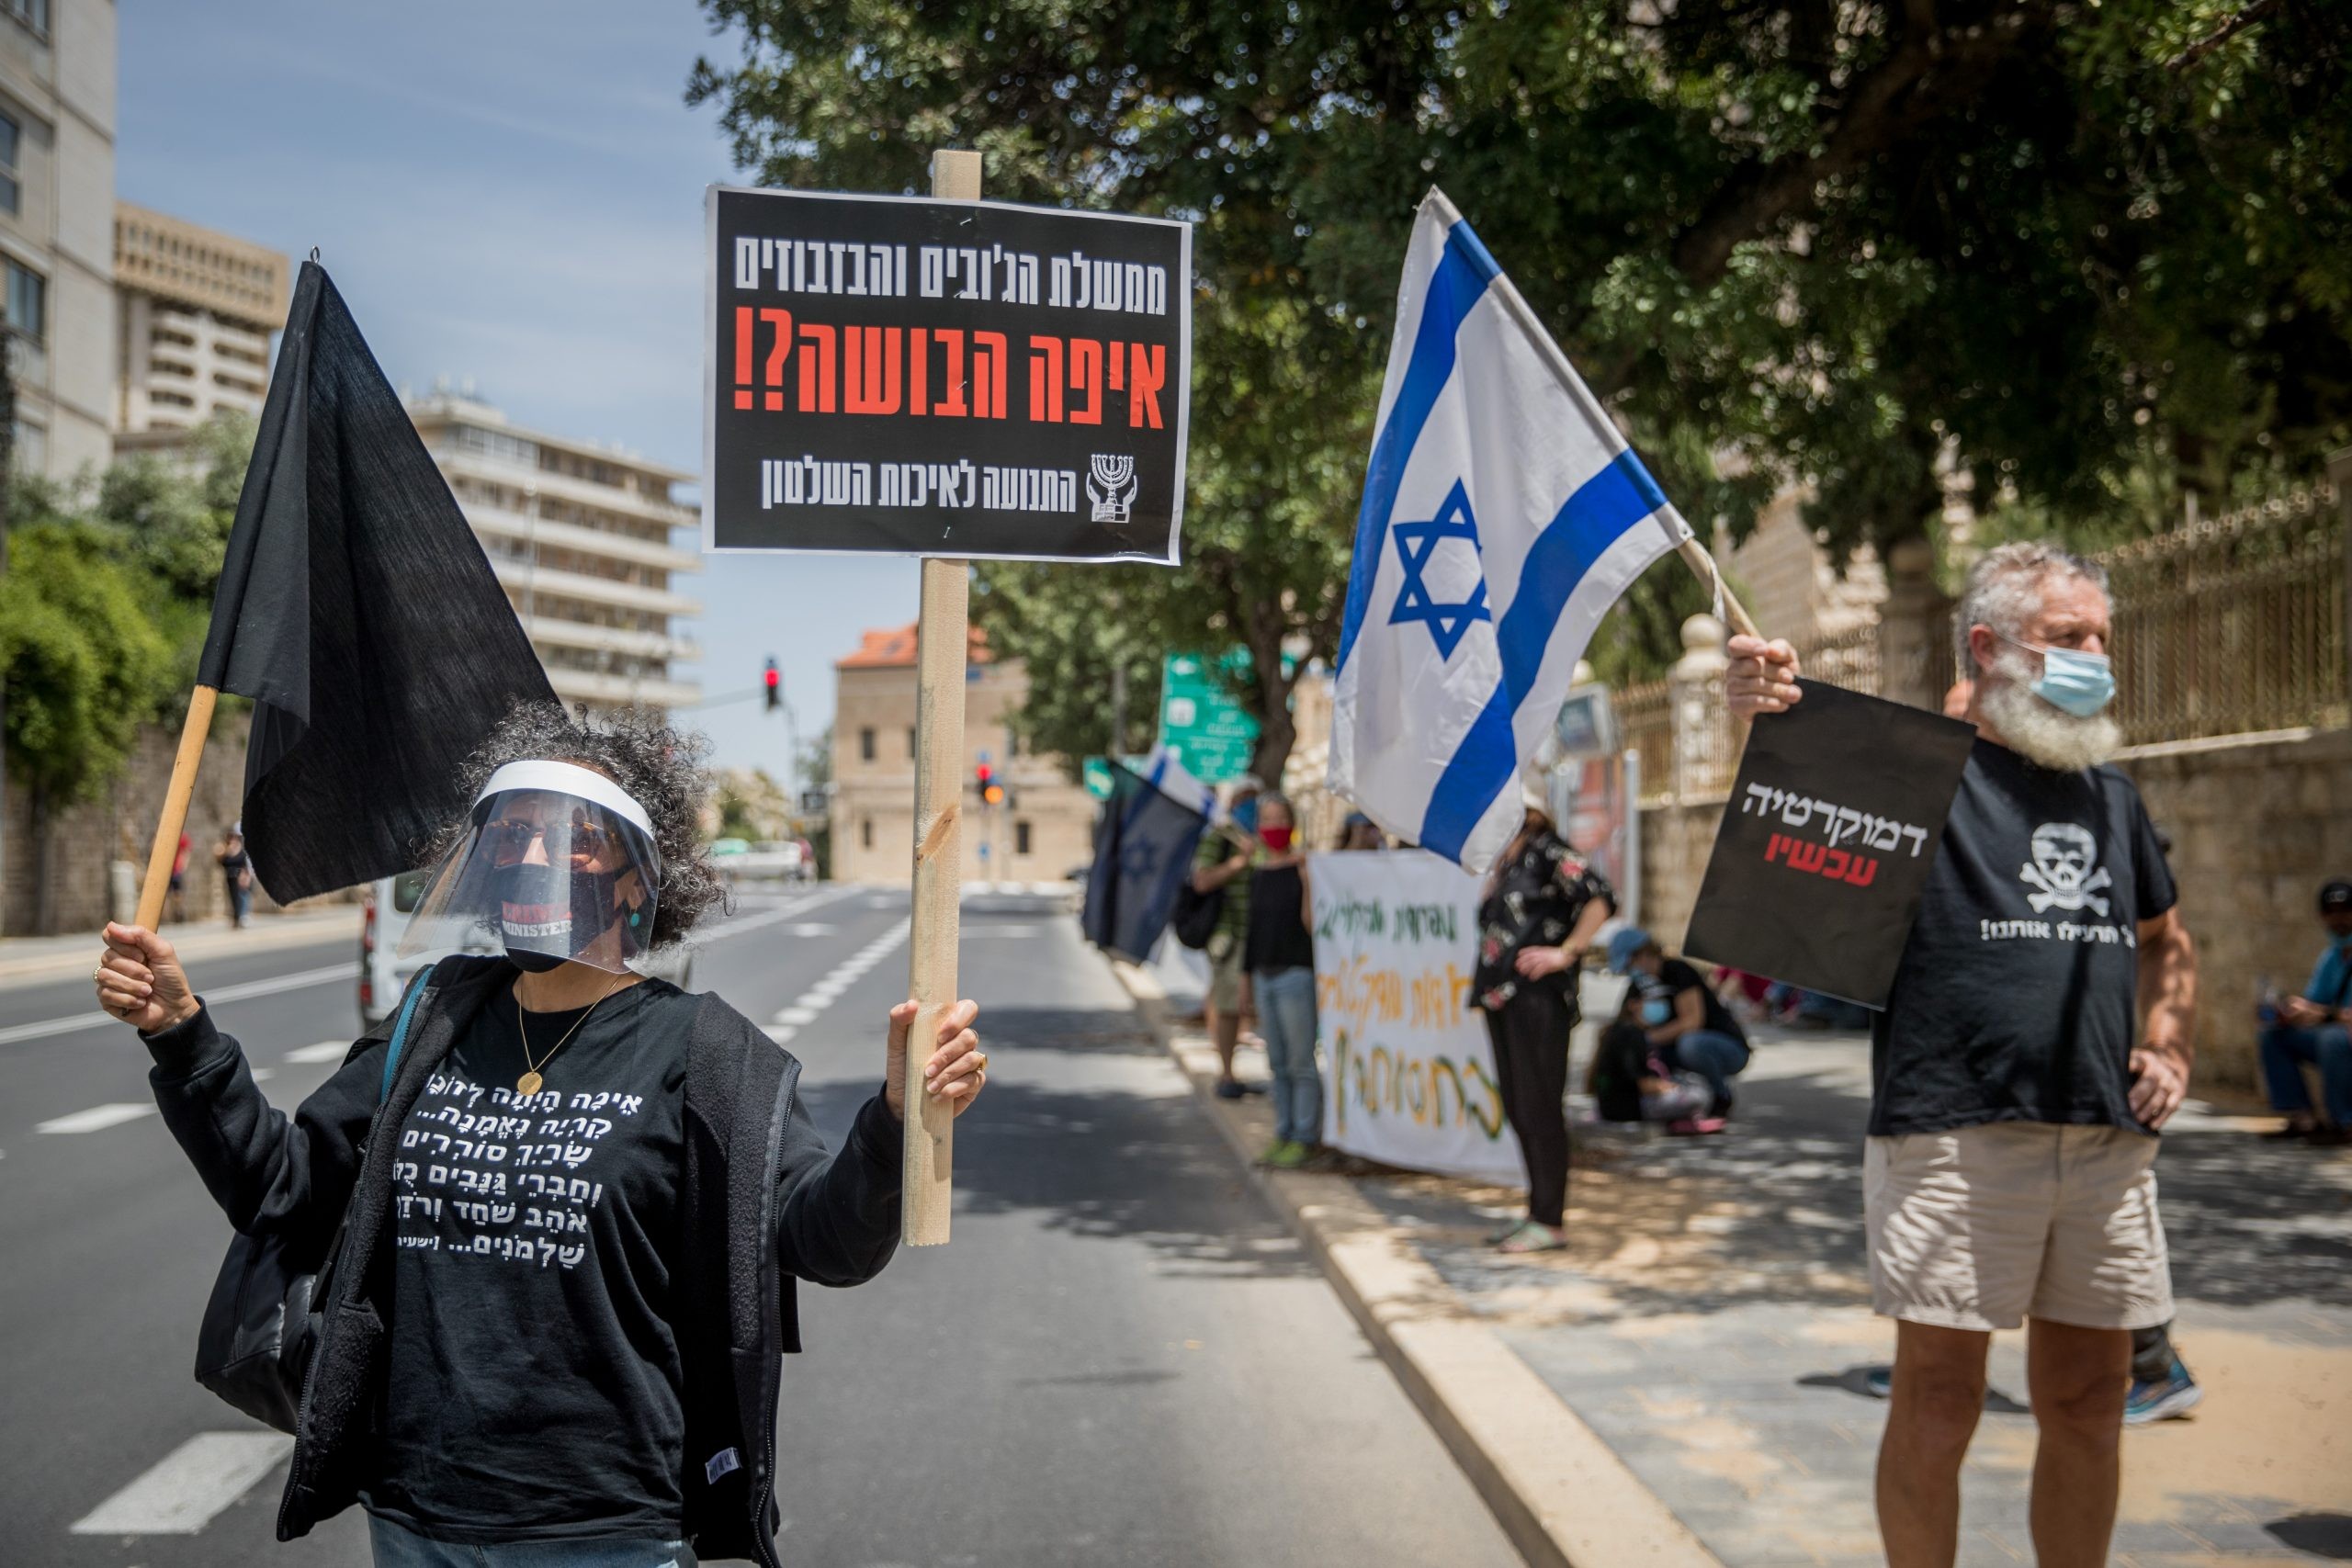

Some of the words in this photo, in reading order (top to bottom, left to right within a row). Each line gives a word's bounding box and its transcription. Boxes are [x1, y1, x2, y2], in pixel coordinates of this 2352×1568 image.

[735, 237, 907, 297] והבזבוזים
[1048, 251, 1166, 316] ממשלת
[733, 306, 1008, 420] הבושה?!
[1029, 334, 1166, 430] איפה
[762, 455, 871, 510] השלטון
[877, 458, 977, 508] לאיכות
[983, 466, 1077, 513] התנועה
[1742, 783, 1928, 857] דמוקרטיה
[1764, 833, 1878, 886] עכשיו
